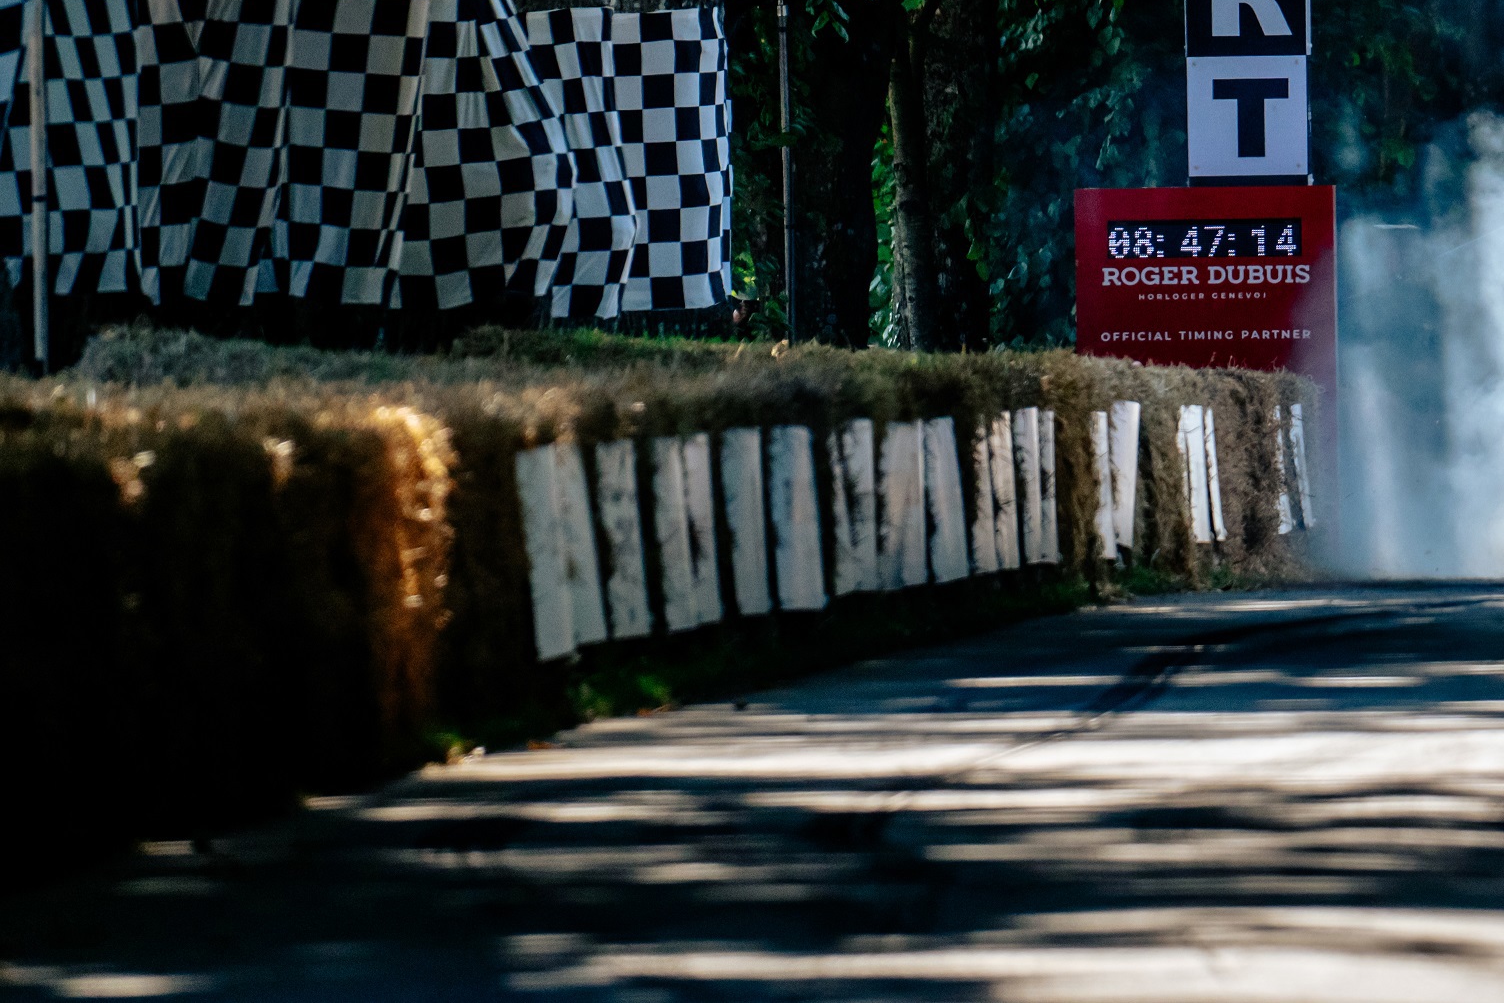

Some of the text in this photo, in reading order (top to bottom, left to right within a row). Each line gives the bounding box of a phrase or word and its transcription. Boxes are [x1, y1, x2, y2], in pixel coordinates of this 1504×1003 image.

[1101, 264, 1311, 286] ROGER DUBUIS
[1138, 292, 1205, 301] HORLOGER
[1100, 329, 1311, 342] OFFICIAL TIMING PARTNER
